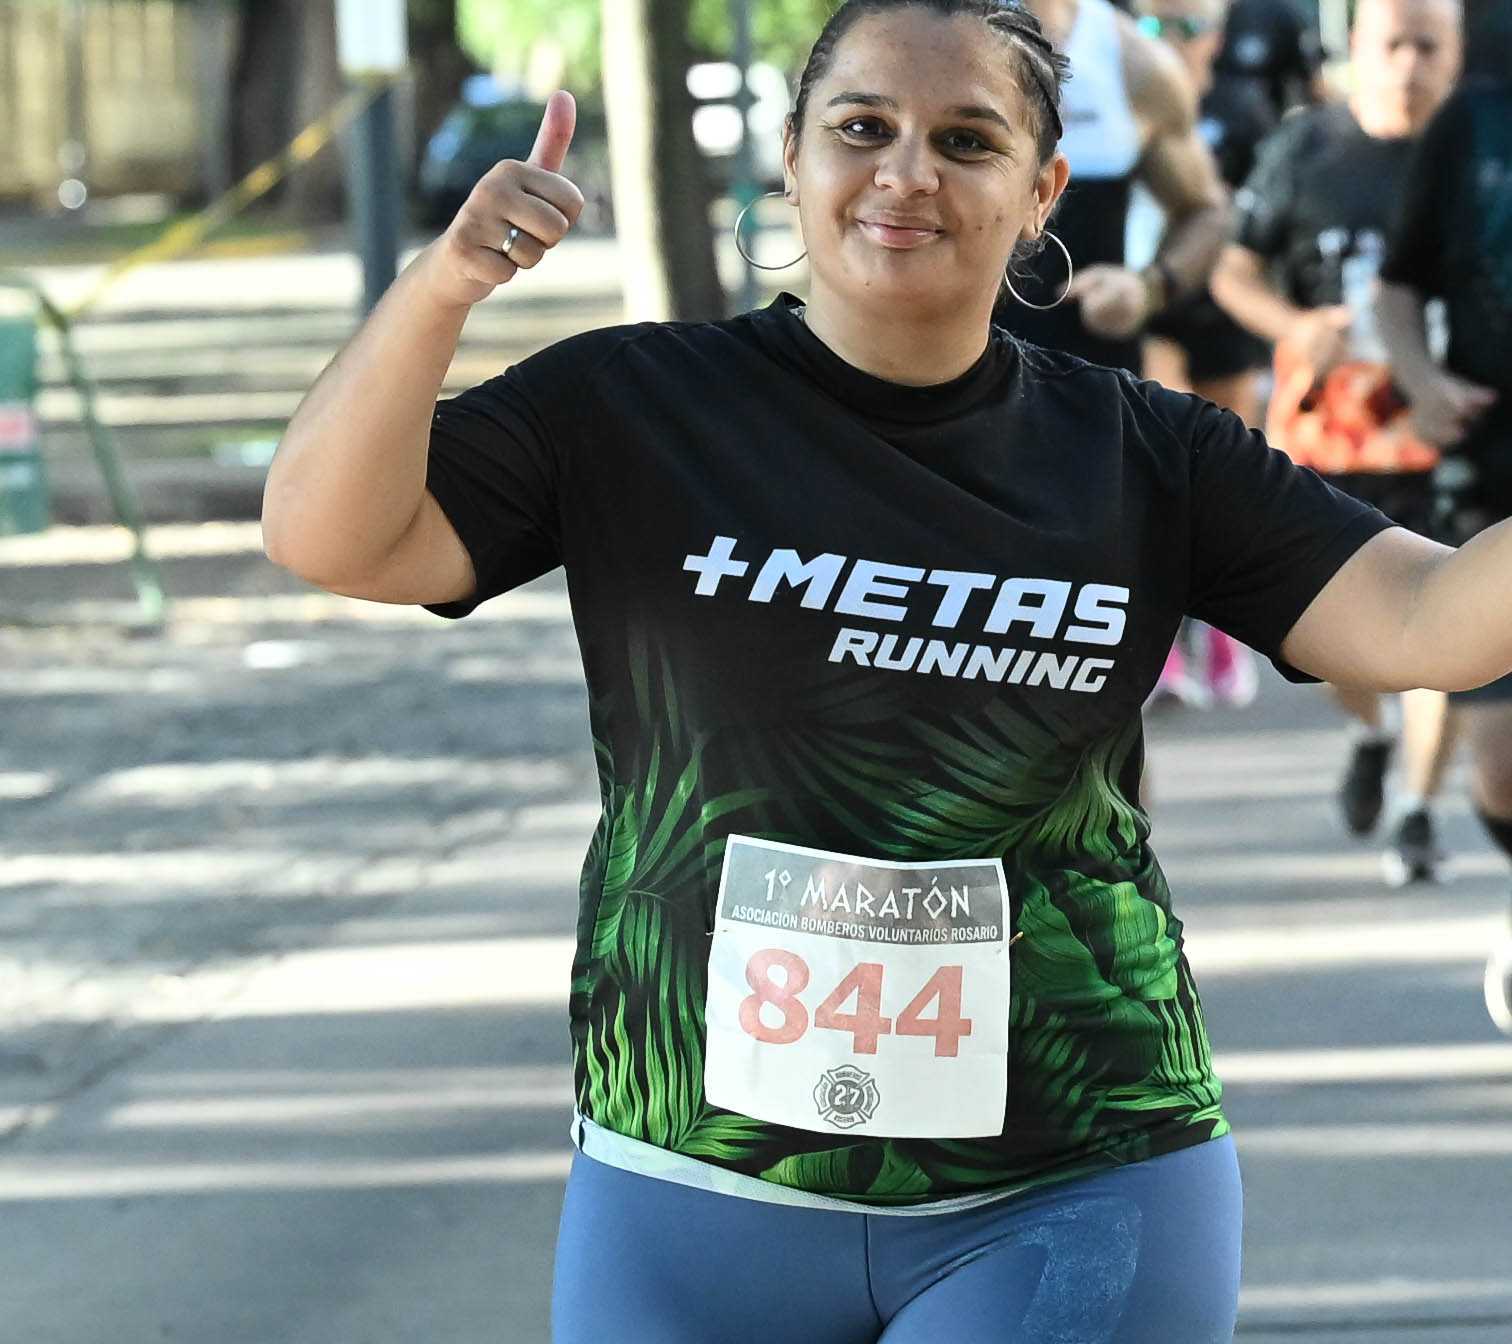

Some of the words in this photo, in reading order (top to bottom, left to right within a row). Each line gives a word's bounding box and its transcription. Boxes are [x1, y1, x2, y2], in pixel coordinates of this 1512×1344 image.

[682, 535, 1130, 646] +METAS
[828, 627, 1115, 693] RUNNING
[799, 874, 971, 920] MARATÓN
[800, 916, 866, 939] BOMBEROS
[868, 925, 949, 943] VOLUNTARIOS
[951, 924, 999, 942] ROSARIO
[738, 947, 973, 1058] 844
[833, 1083, 862, 1106] 27
